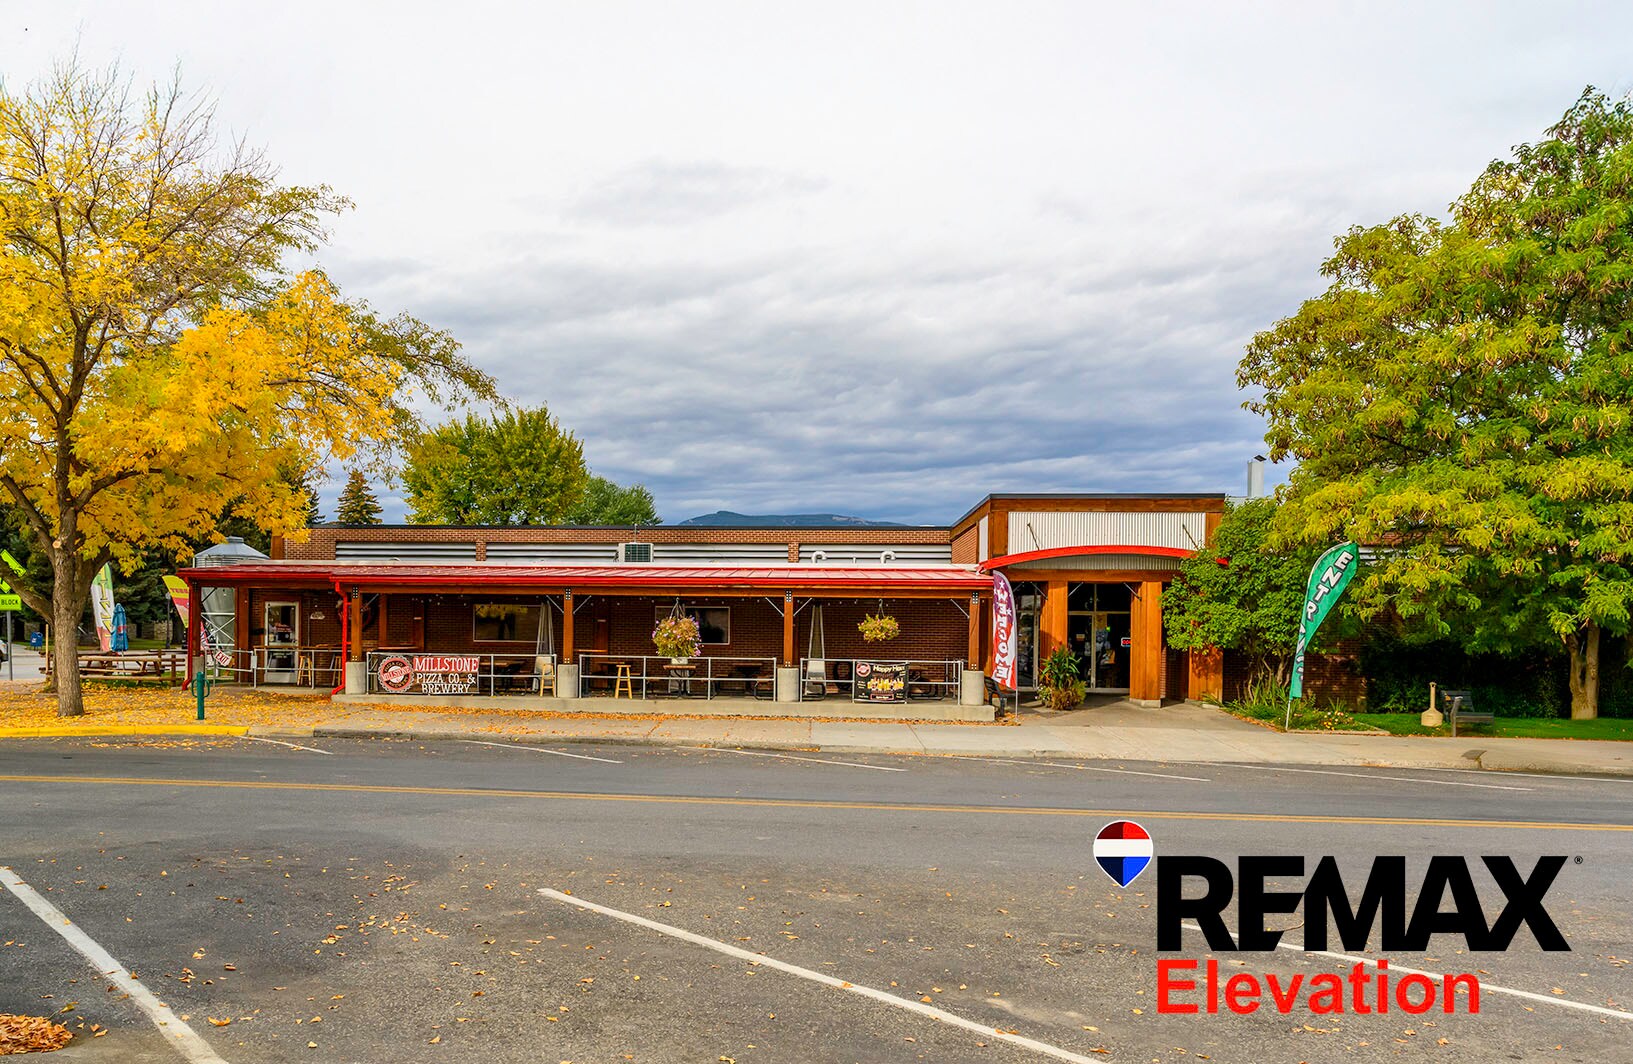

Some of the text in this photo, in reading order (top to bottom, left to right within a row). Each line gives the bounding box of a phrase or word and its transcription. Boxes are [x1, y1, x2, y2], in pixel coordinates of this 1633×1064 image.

[1296, 550, 1354, 682] ENTR
[995, 588, 1010, 679] WELCOME
[215, 651, 229, 664] EXIT
[415, 657, 479, 671] MILLSTONE
[873, 665, 891, 673] Happy
[416, 673, 477, 684] PIZZA CO. &
[422, 683, 470, 694] BREWERY
